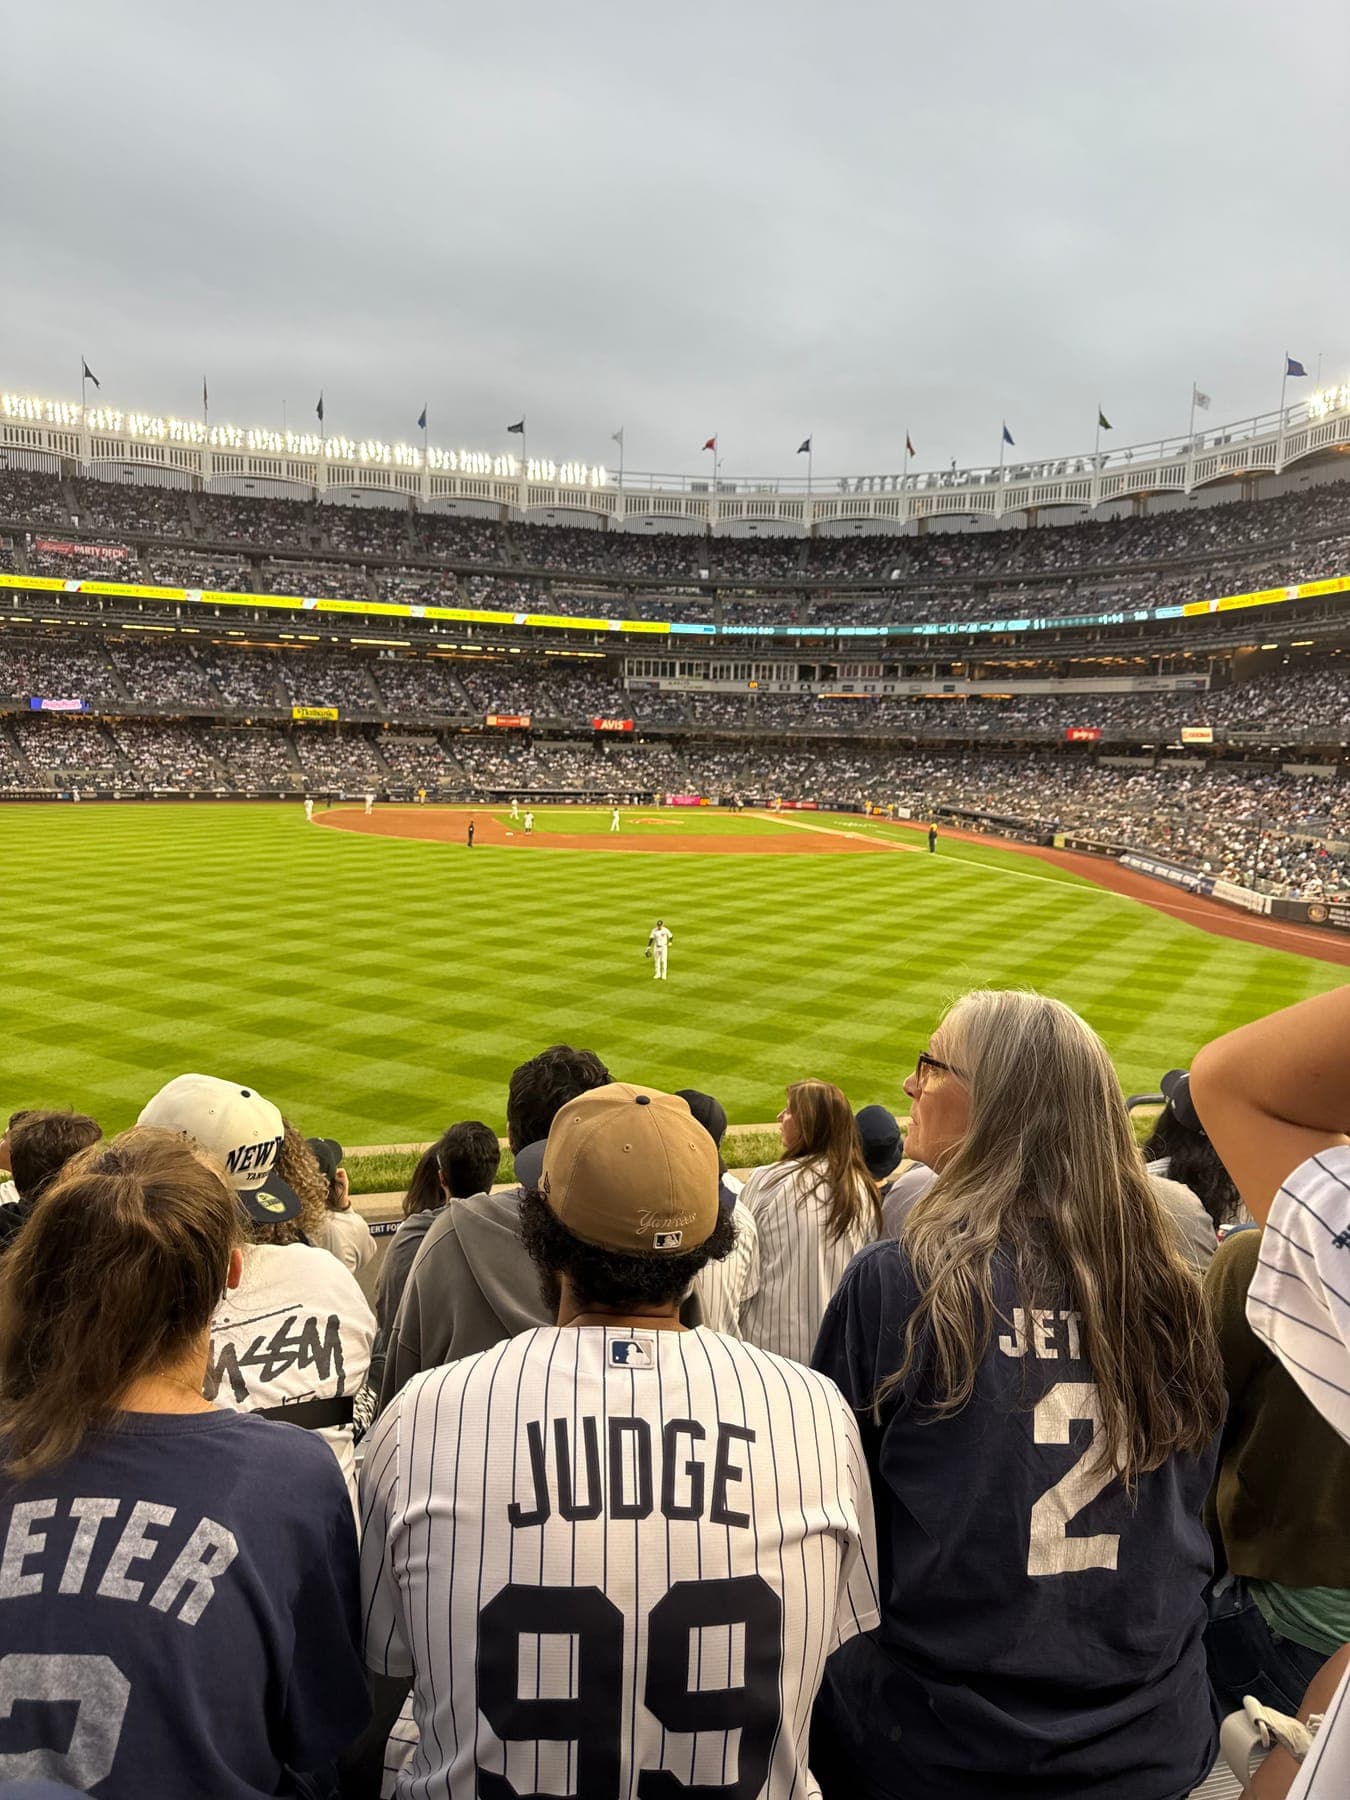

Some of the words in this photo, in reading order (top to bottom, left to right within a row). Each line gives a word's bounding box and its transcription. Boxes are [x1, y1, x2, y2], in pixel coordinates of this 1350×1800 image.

[74, 545, 100, 556] PARTY
[102, 547, 125, 559] DECK
[600, 719, 625, 730] AVIS
[225, 1141, 275, 1175] NEW
[999, 1308, 1081, 1360] JET
[508, 1416, 756, 1529] JUDGE
[1027, 1382, 1128, 1576] 2
[0, 1497, 239, 1626] ETER
[476, 1574, 782, 1800] 99
